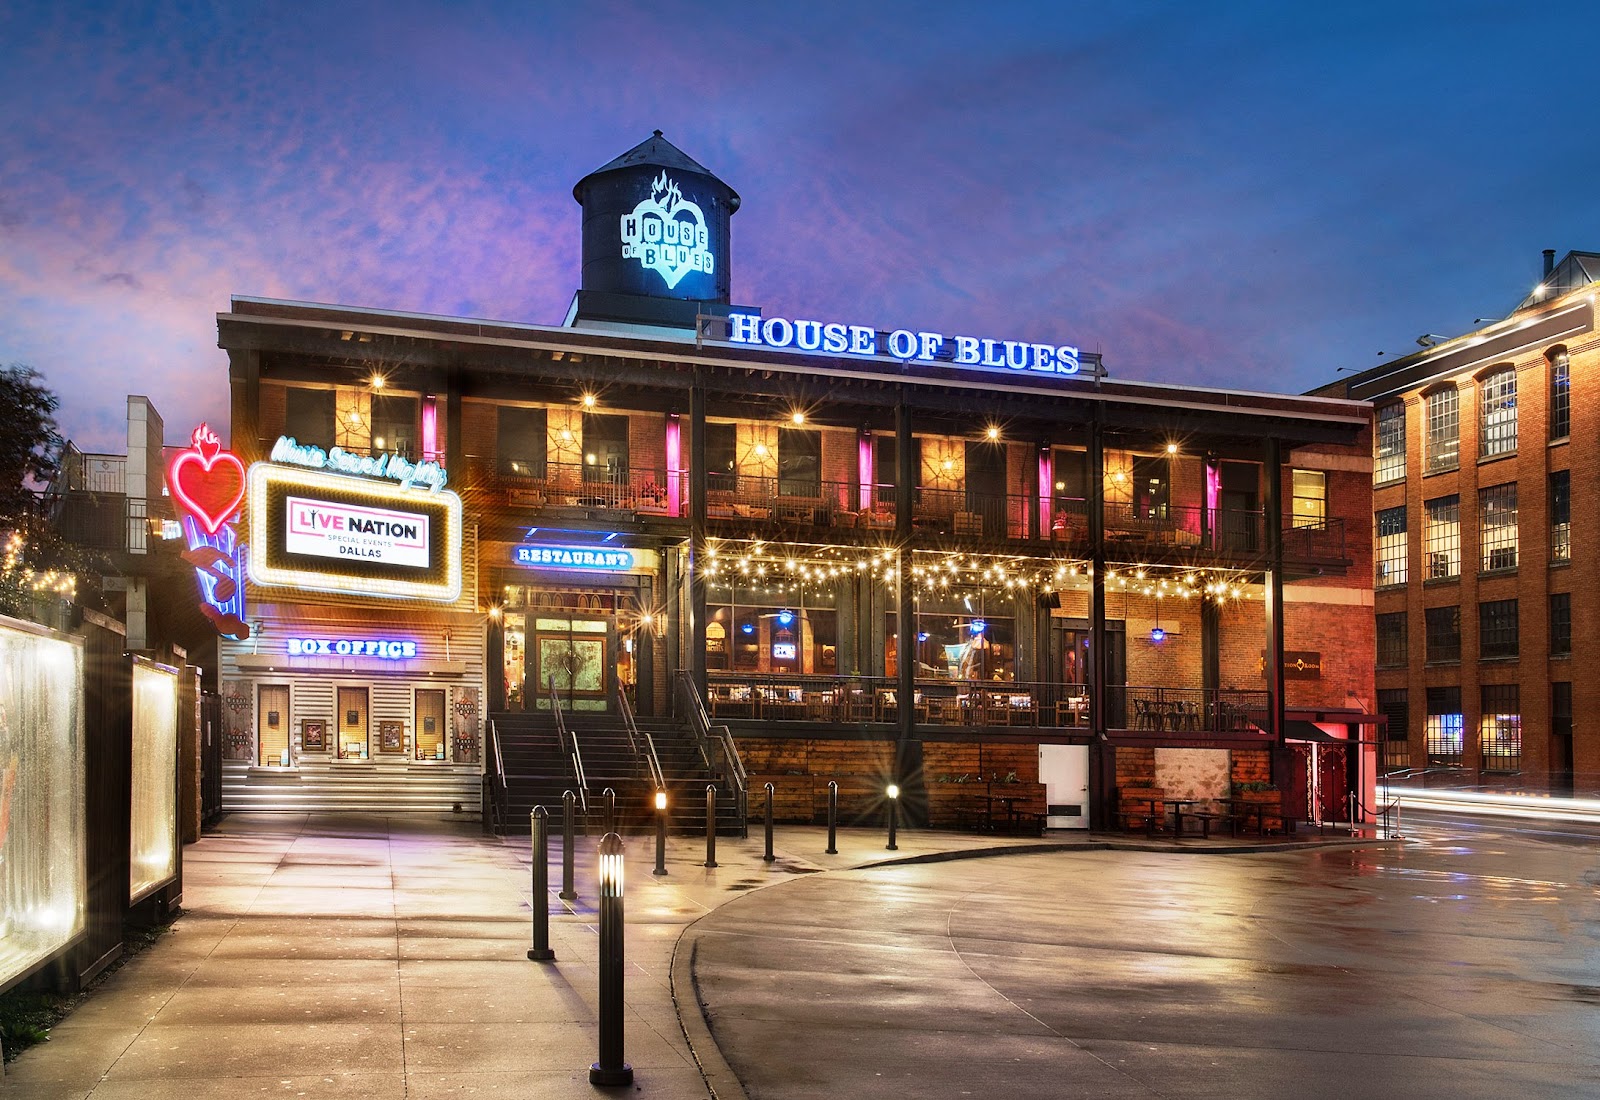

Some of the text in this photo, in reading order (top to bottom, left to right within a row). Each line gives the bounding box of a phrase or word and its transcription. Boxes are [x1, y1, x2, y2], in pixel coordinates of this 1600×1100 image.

[626, 219, 705, 244] HOUSE
[645, 249, 712, 268] BLUES
[728, 312, 1080, 375] HOUSE OF BLUES
[270, 435, 327, 468] Music
[327, 446, 388, 477] Served
[300, 508, 417, 540] LIVE NATION
[327, 534, 392, 547] SPECIAL EVENTS
[339, 545, 382, 558] DALLAS
[518, 548, 629, 566] RESTAURANT
[286, 638, 417, 658] BOX OFFICE
